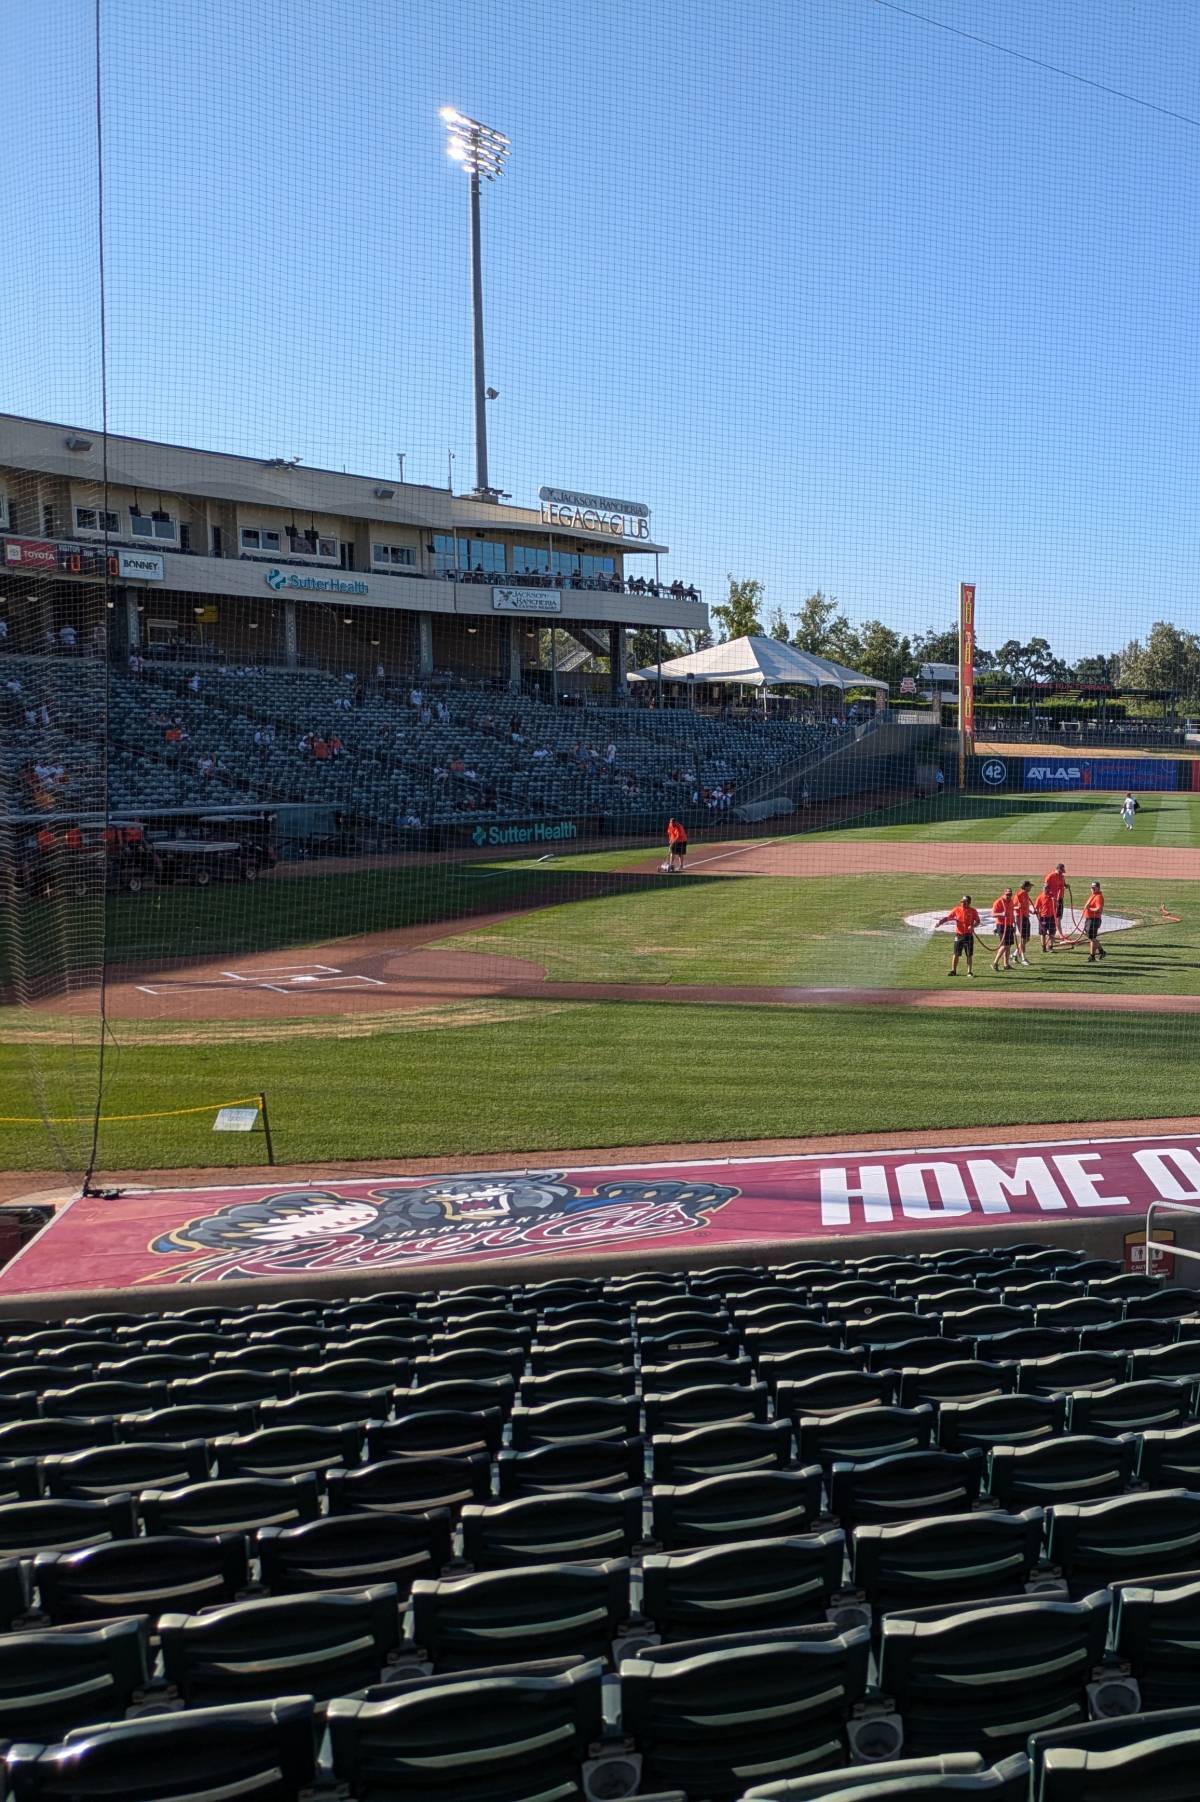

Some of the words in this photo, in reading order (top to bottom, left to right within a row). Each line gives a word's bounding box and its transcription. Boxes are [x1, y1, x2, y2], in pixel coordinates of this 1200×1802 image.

[541, 502, 606, 533] LEGACY
[610, 514, 650, 539] CLUB
[23, 550, 55, 561] TOYOTA
[123, 559, 158, 571] BONNEY
[290, 575, 328, 590] Sutter
[330, 579, 369, 593] Health
[985, 765, 1002, 778] 42
[1026, 767, 1080, 780] ATLAS
[489, 826, 533, 844] Sutter
[534, 822, 577, 840] Health
[819, 1152, 1130, 1227] HOME
[379, 1211, 566, 1240] SACRAMENTO
[522, 1201, 700, 1243] Cats
